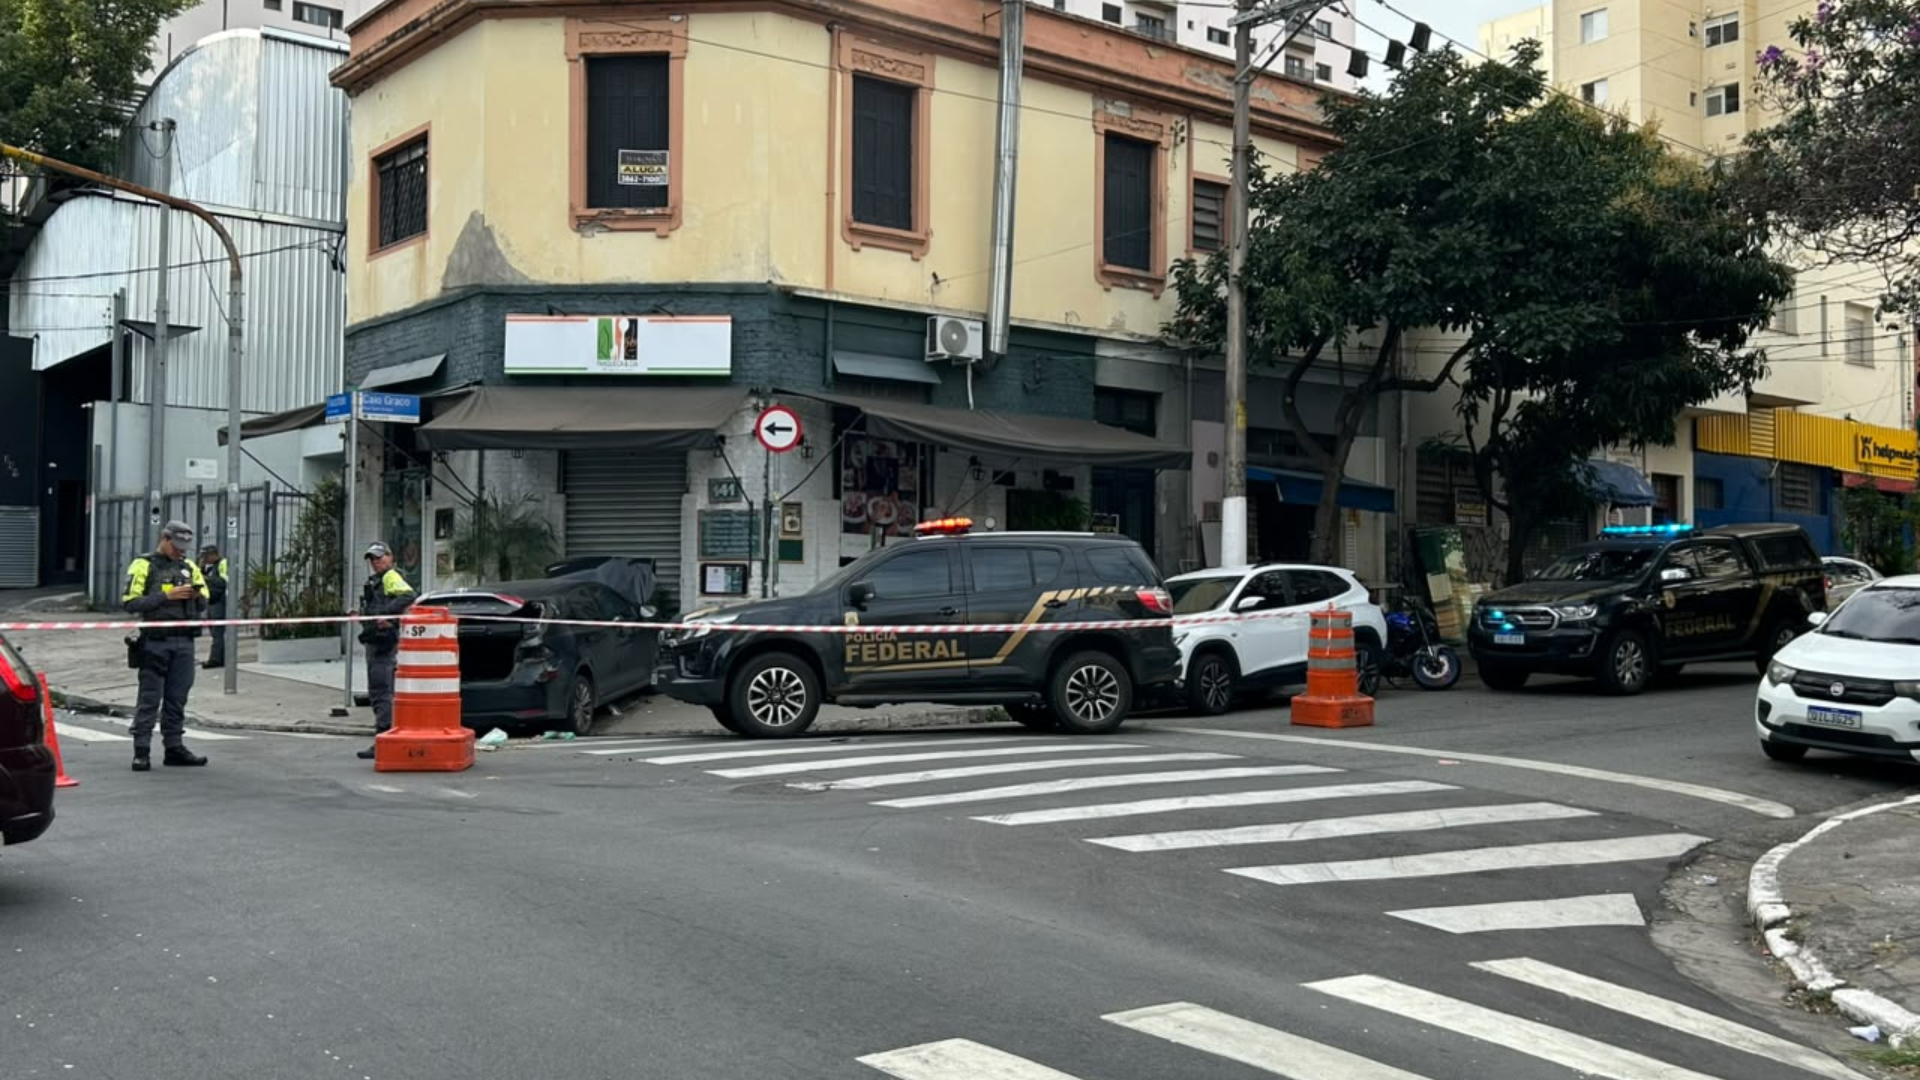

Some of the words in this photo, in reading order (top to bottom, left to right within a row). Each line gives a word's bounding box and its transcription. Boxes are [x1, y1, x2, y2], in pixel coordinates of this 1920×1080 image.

[623, 165, 664, 173] ALUGA
[363, 394, 382, 405] Caio
[384, 395, 411, 408] Graco
[1665, 614, 1736, 637] FEDERAL
[846, 639, 965, 663] FEDERAL
